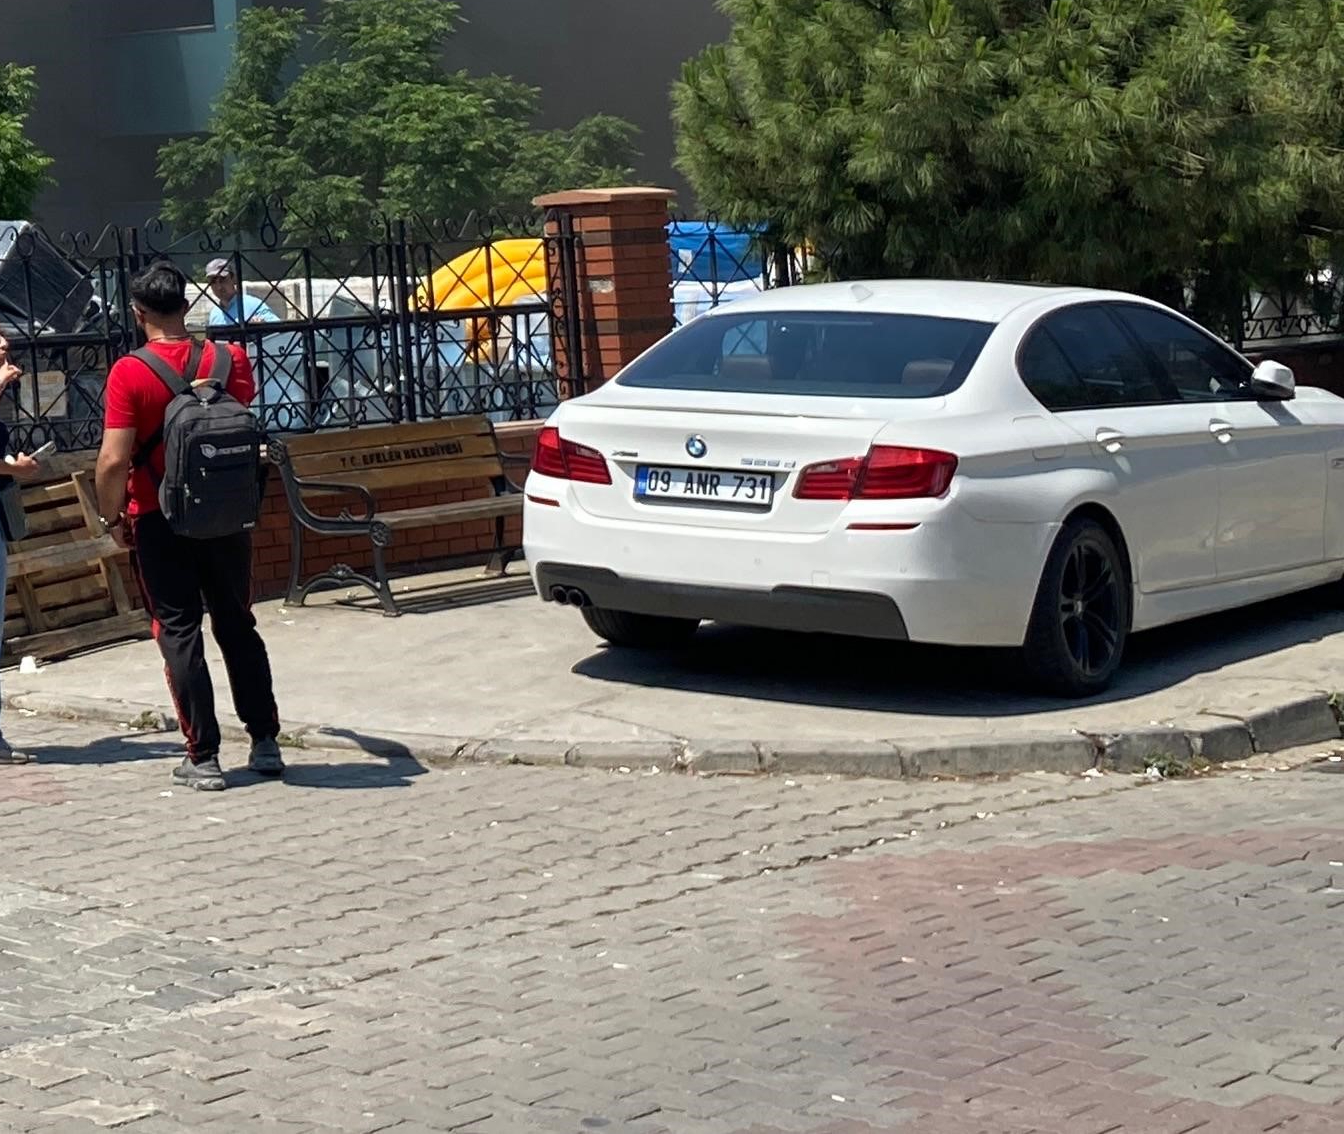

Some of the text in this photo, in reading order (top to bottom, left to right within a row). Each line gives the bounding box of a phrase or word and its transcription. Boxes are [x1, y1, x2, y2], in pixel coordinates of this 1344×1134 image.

[648, 470, 768, 500] 09 ANR 731
